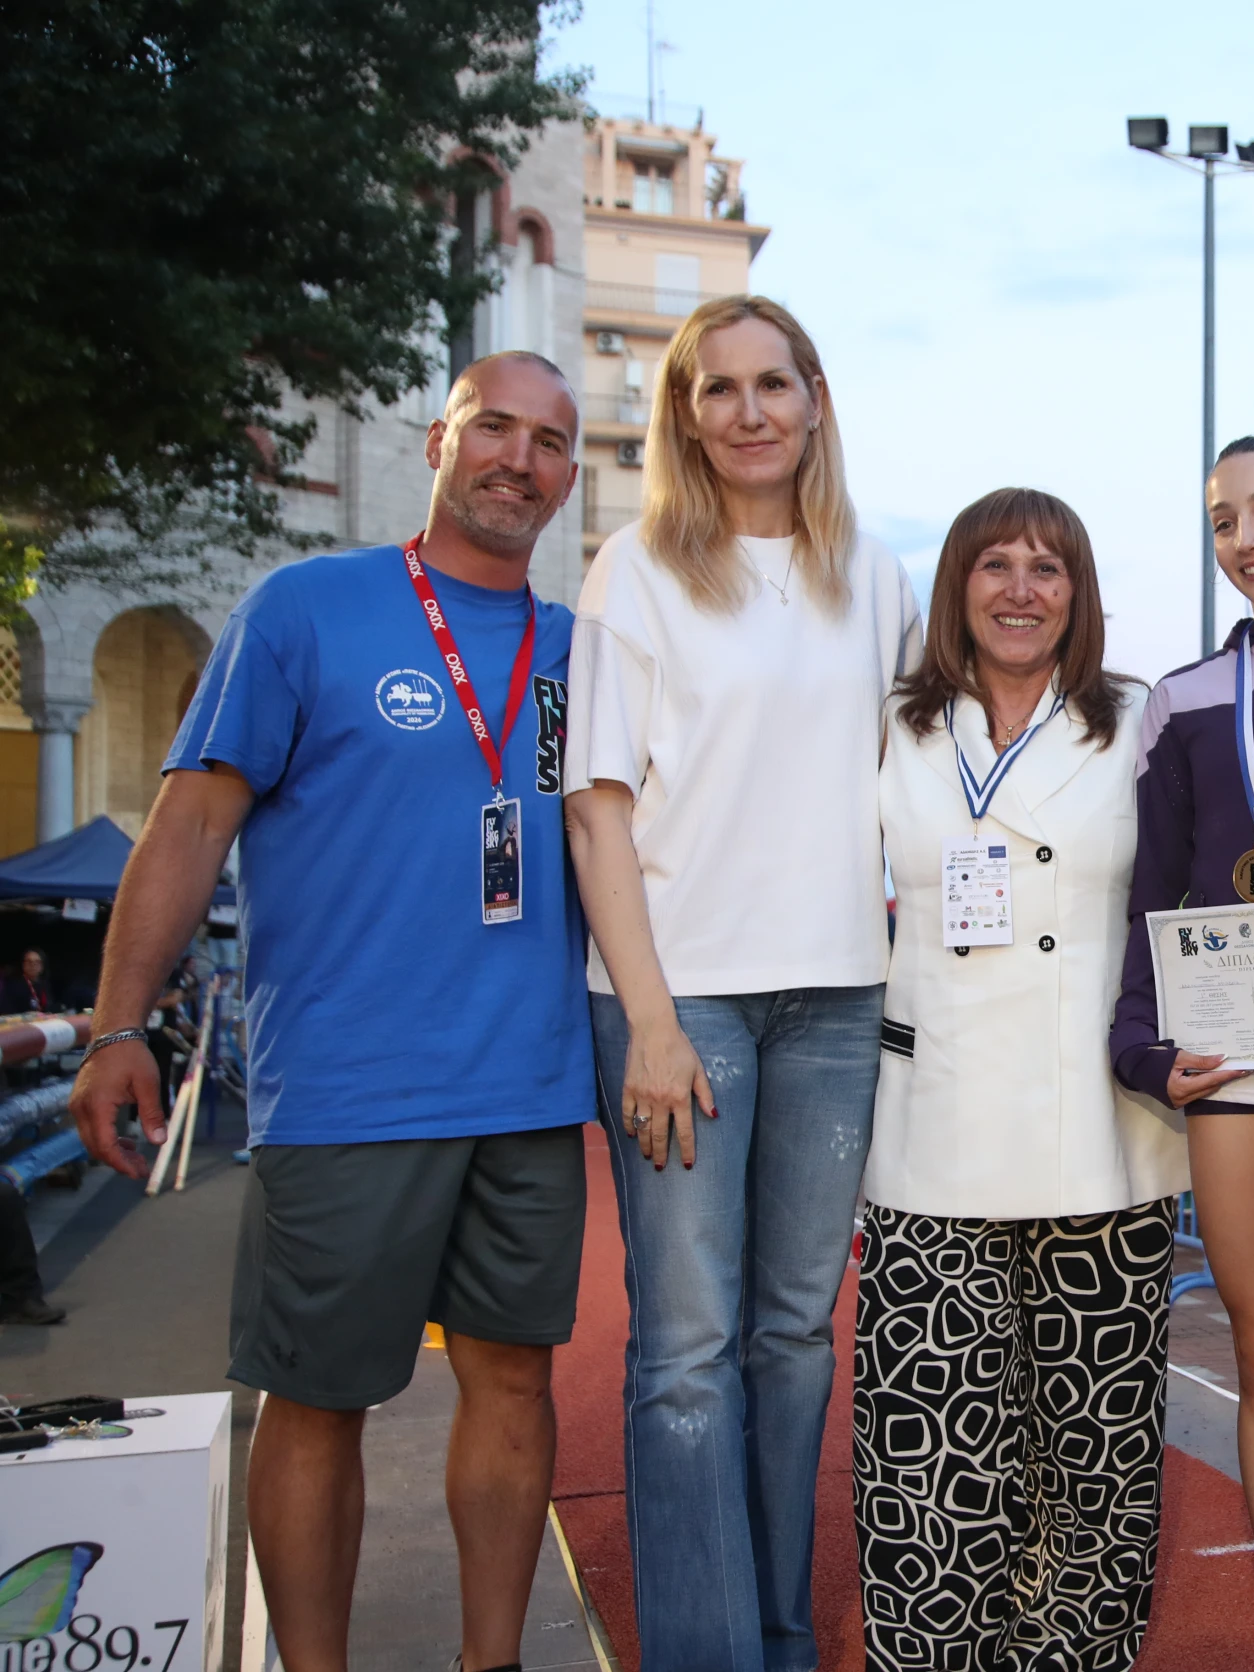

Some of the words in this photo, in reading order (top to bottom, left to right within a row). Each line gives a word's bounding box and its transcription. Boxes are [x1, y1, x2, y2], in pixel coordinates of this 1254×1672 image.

[423, 599, 446, 631] XIXO
[445, 653, 468, 685] XIXO
[467, 707, 489, 741] XIXO
[1178, 927, 1193, 936] FLY
[1180, 941, 1198, 951] SKG
[1181, 948, 1198, 956] SKY
[64, 1613, 190, 1672] 89.7
